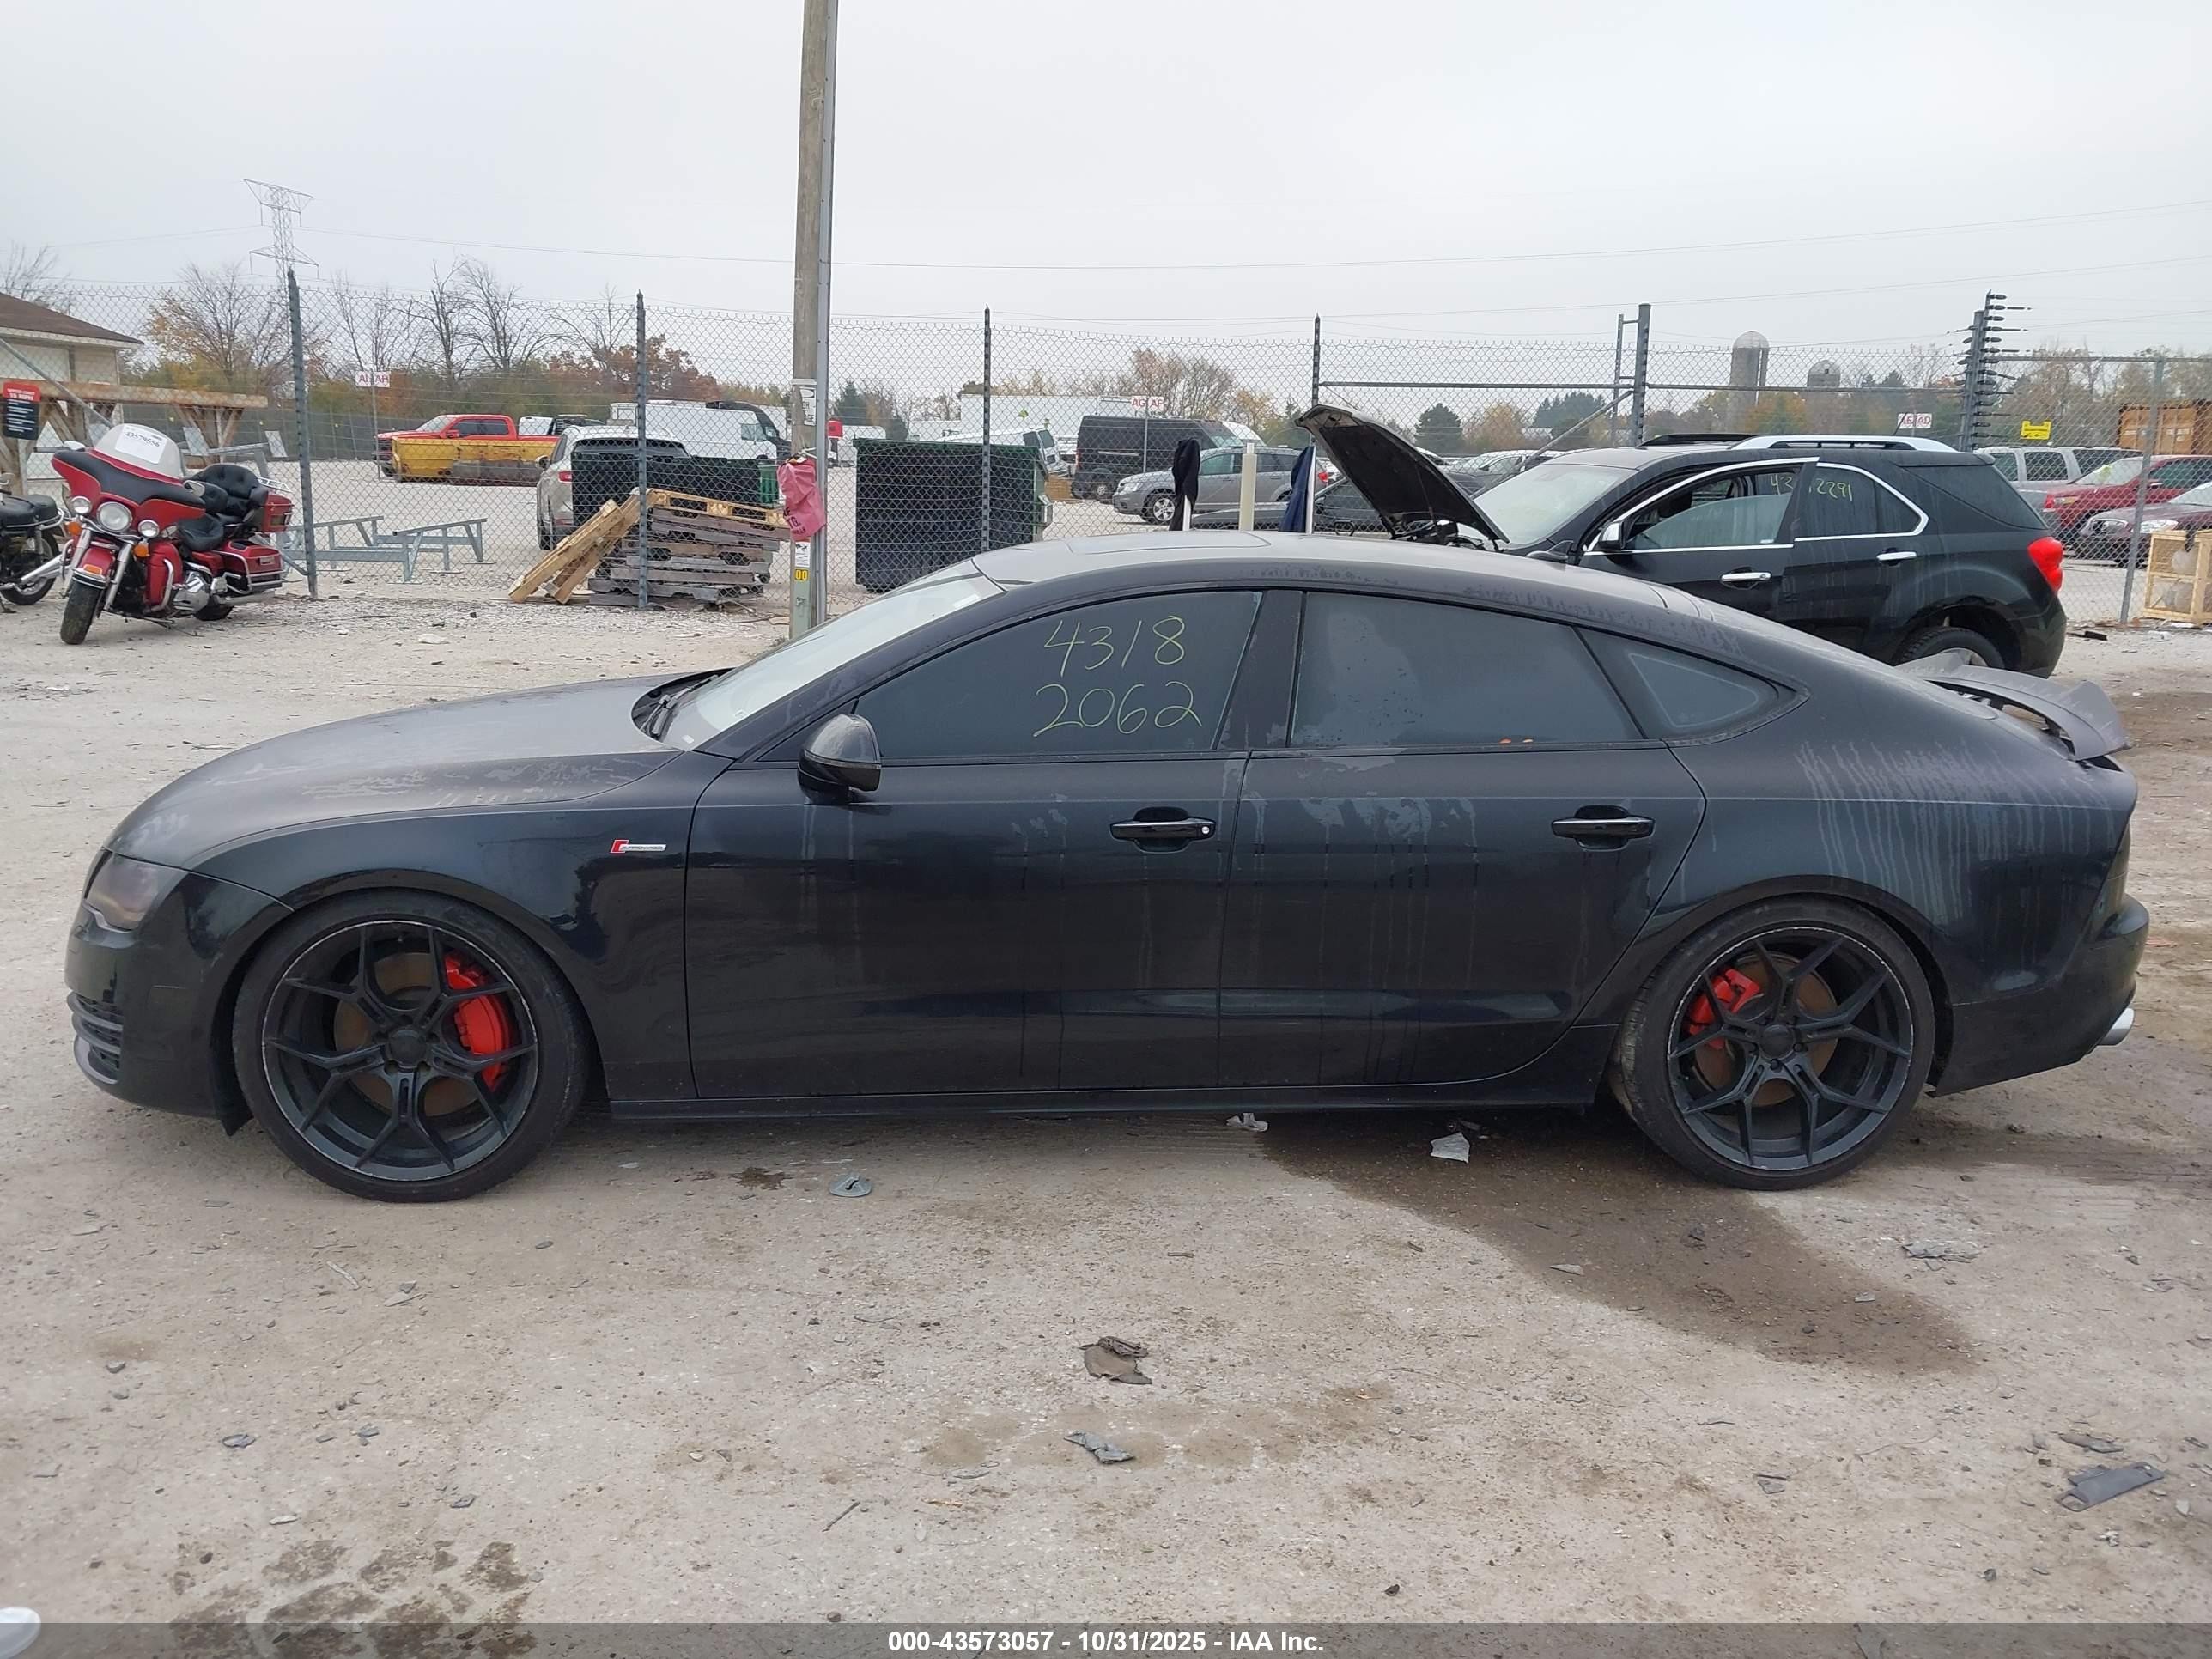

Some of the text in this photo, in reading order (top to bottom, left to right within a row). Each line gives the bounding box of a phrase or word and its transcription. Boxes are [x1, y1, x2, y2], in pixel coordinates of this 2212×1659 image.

[1132, 398, 1146, 408] AG
[1150, 398, 1164, 409] AF
[1043, 615, 1185, 678] 4318
[1033, 681, 1202, 737] 2062
